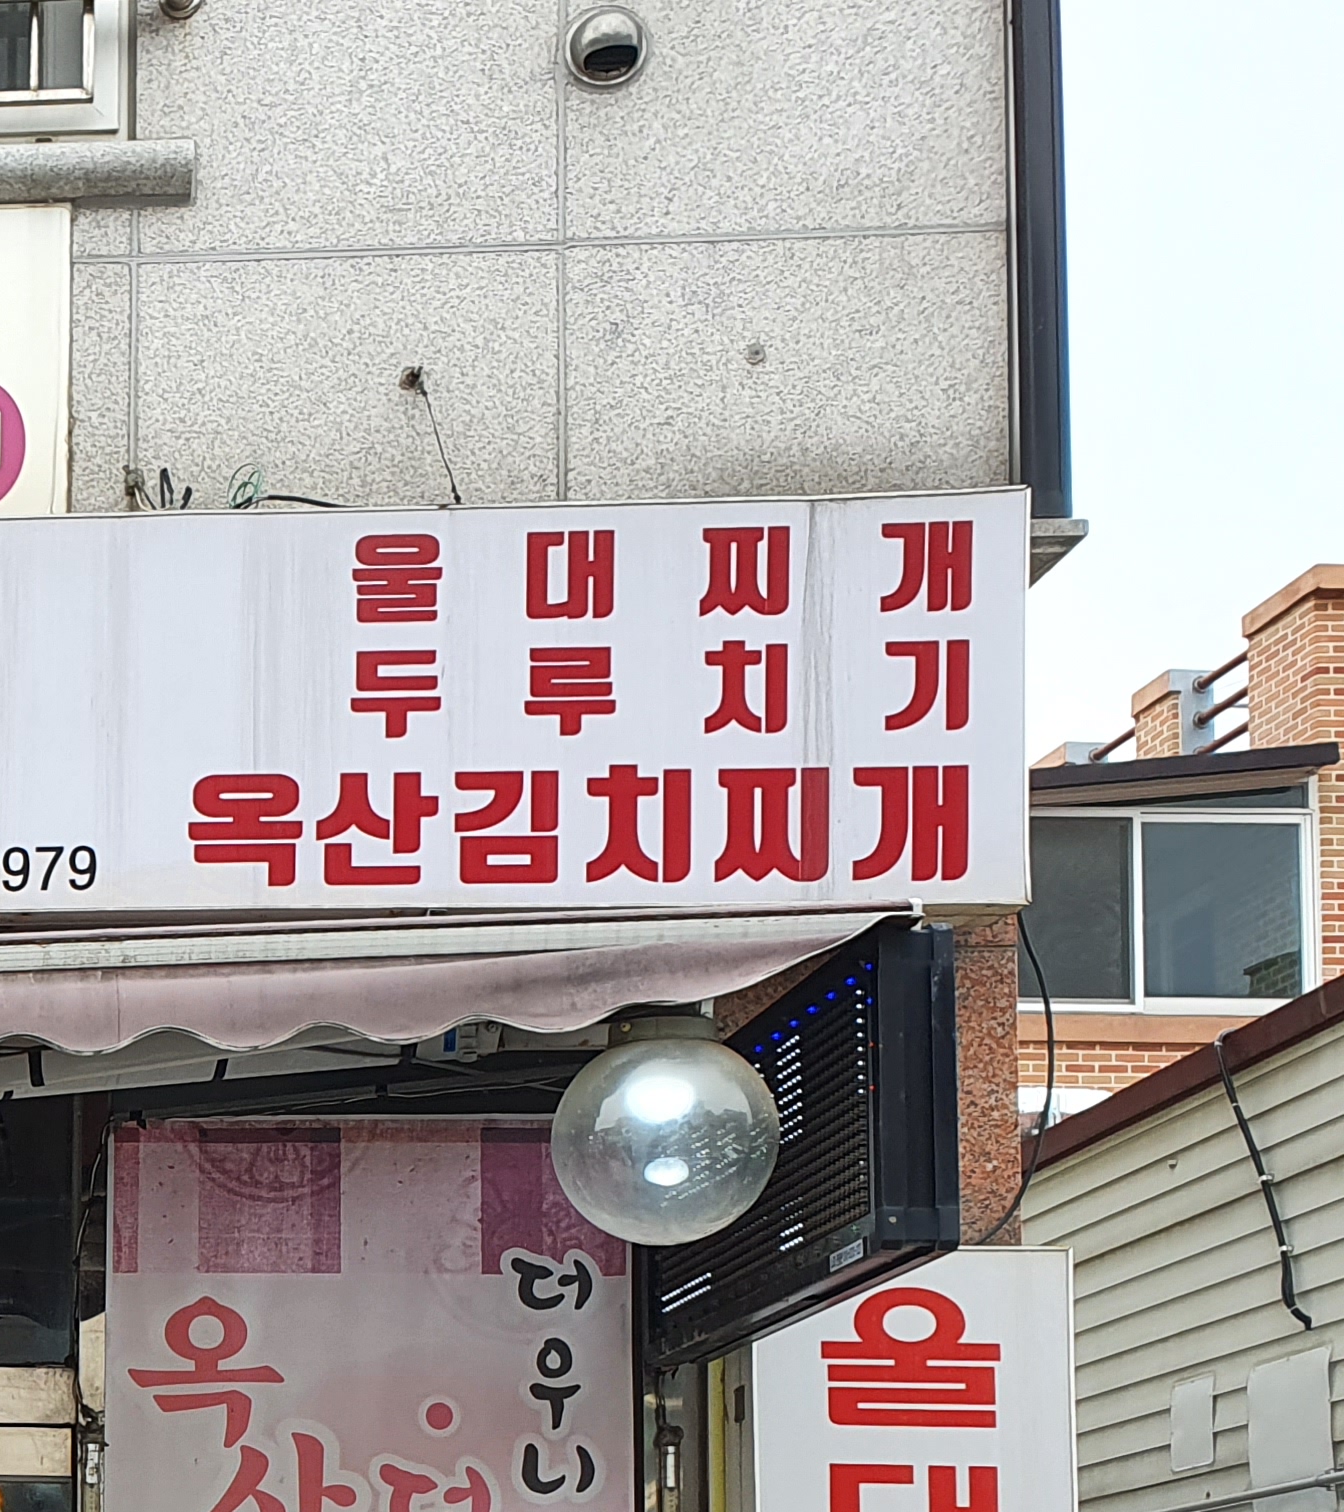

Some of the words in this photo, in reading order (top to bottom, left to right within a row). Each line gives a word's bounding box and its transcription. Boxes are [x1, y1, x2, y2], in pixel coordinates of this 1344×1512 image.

[351, 520, 974, 626] 울대찌개
[349, 639, 971, 740] 두루치기
[186, 763, 970, 888] 옥산김치찌개
